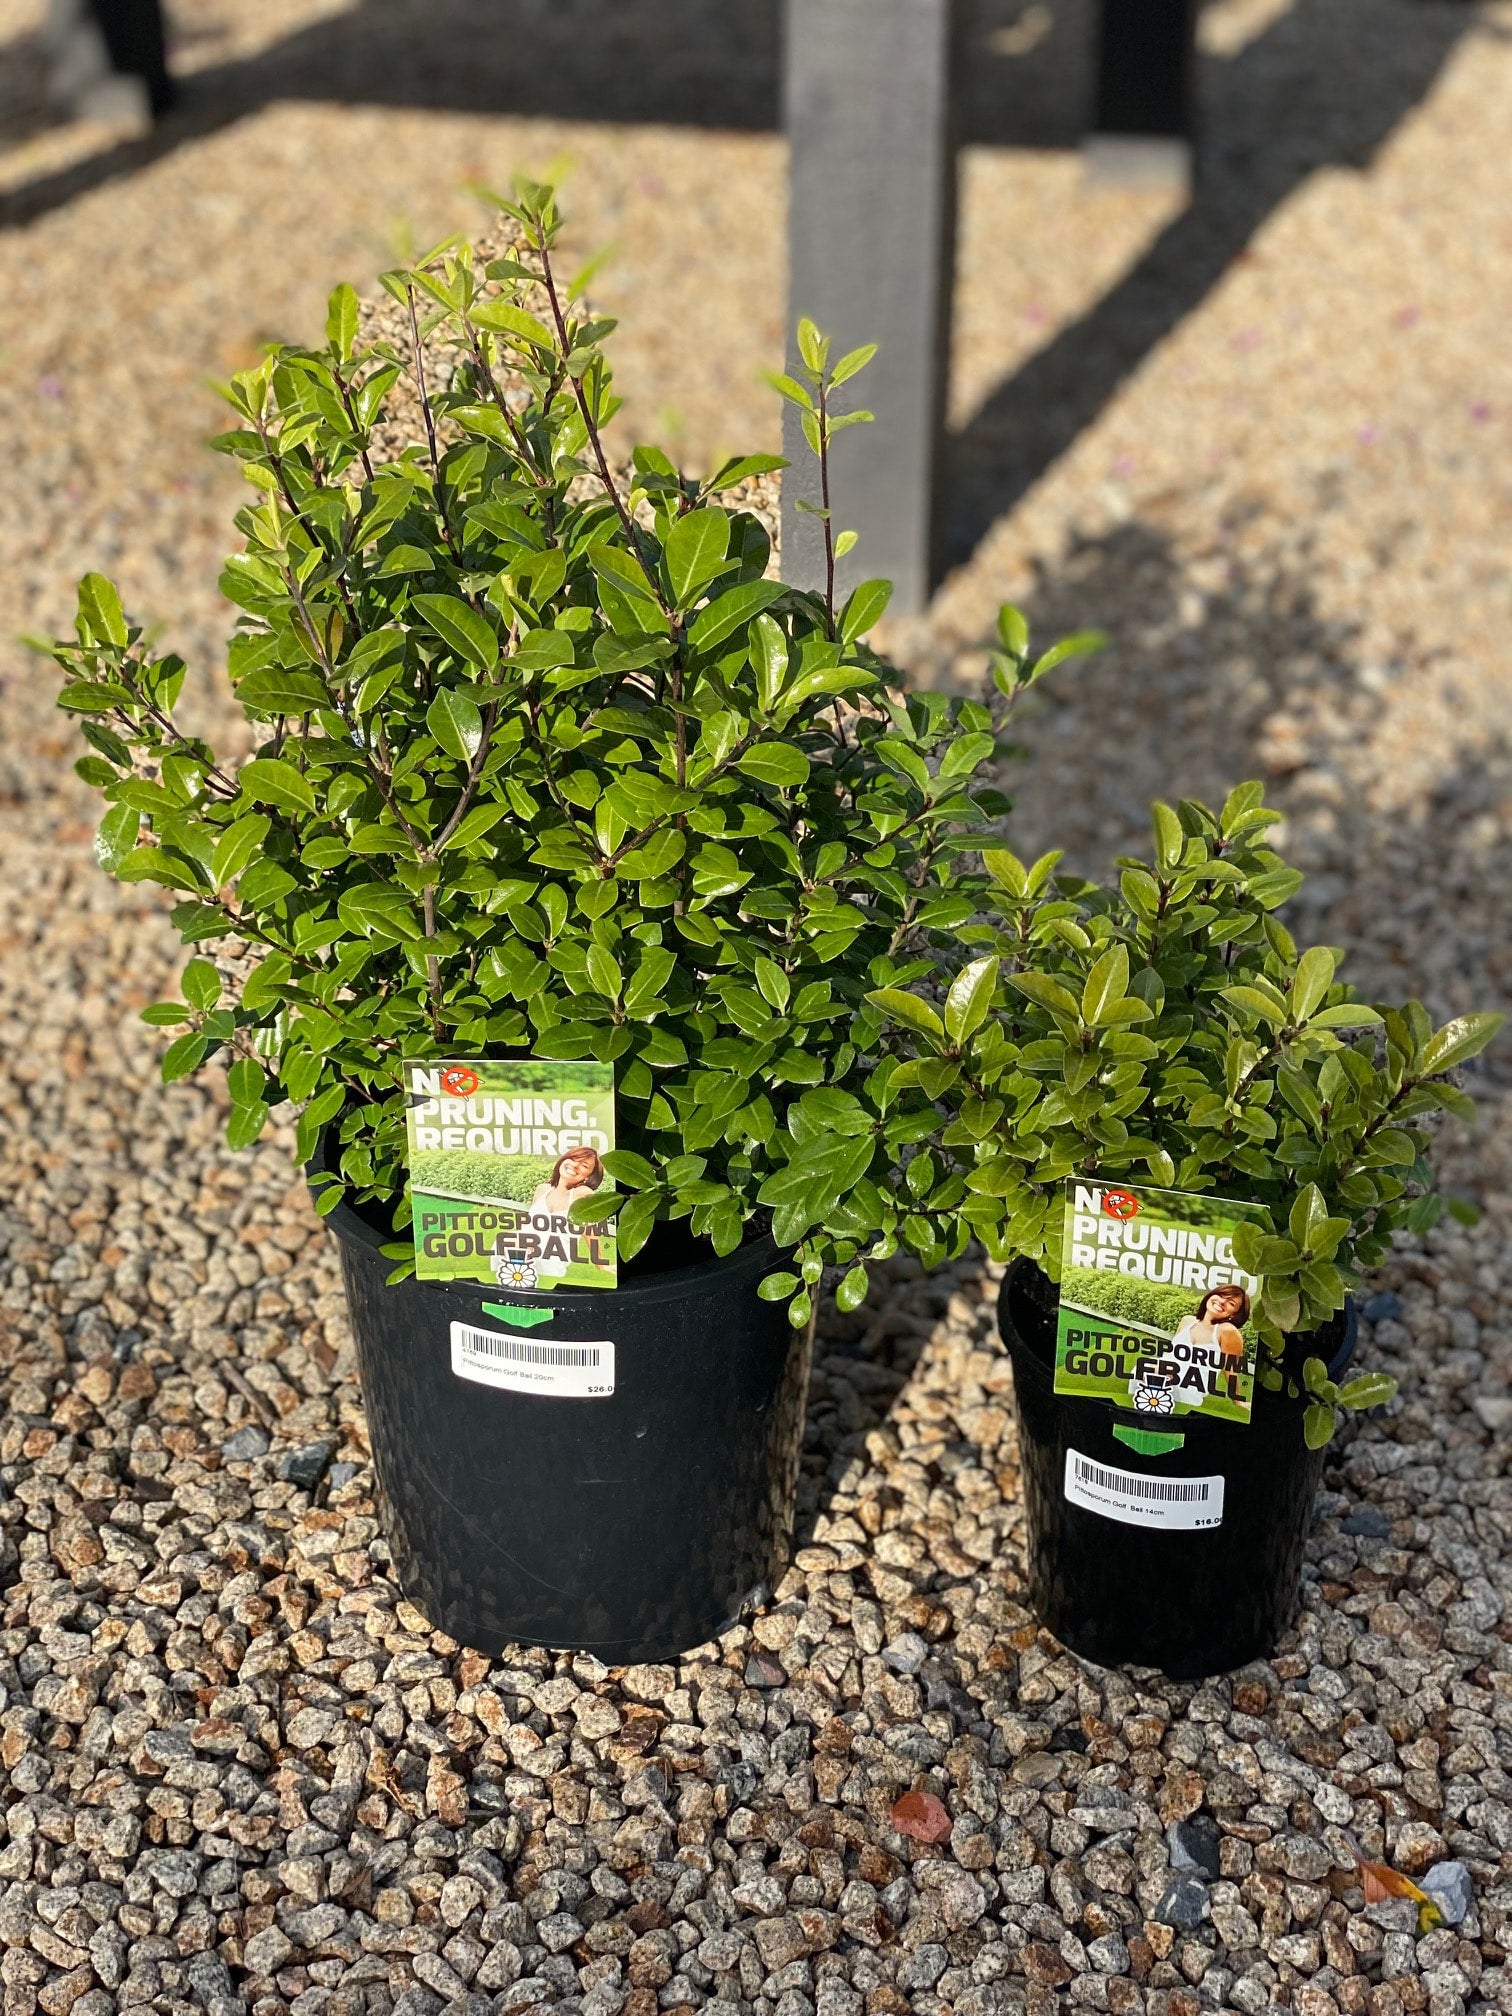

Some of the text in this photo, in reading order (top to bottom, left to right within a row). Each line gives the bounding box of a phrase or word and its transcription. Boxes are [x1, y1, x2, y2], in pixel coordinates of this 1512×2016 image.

[415, 1127, 609, 1157] REQUIRED
[421, 1212, 610, 1238] PITTOSPORUM
[423, 1232, 611, 1266] GOLFBALL
[1071, 1243, 1258, 1297] REQUIRED
[1066, 1328, 1250, 1376] PITTOSPORUM
[462, 1357, 555, 1381] Pittosporum Golf Ball 20cm
[1064, 1350, 1247, 1402] GOLFBALL
[587, 1385, 615, 1393] $26.0
[1074, 1484, 1165, 1516] Pittosporum Golf Ball 14cm
